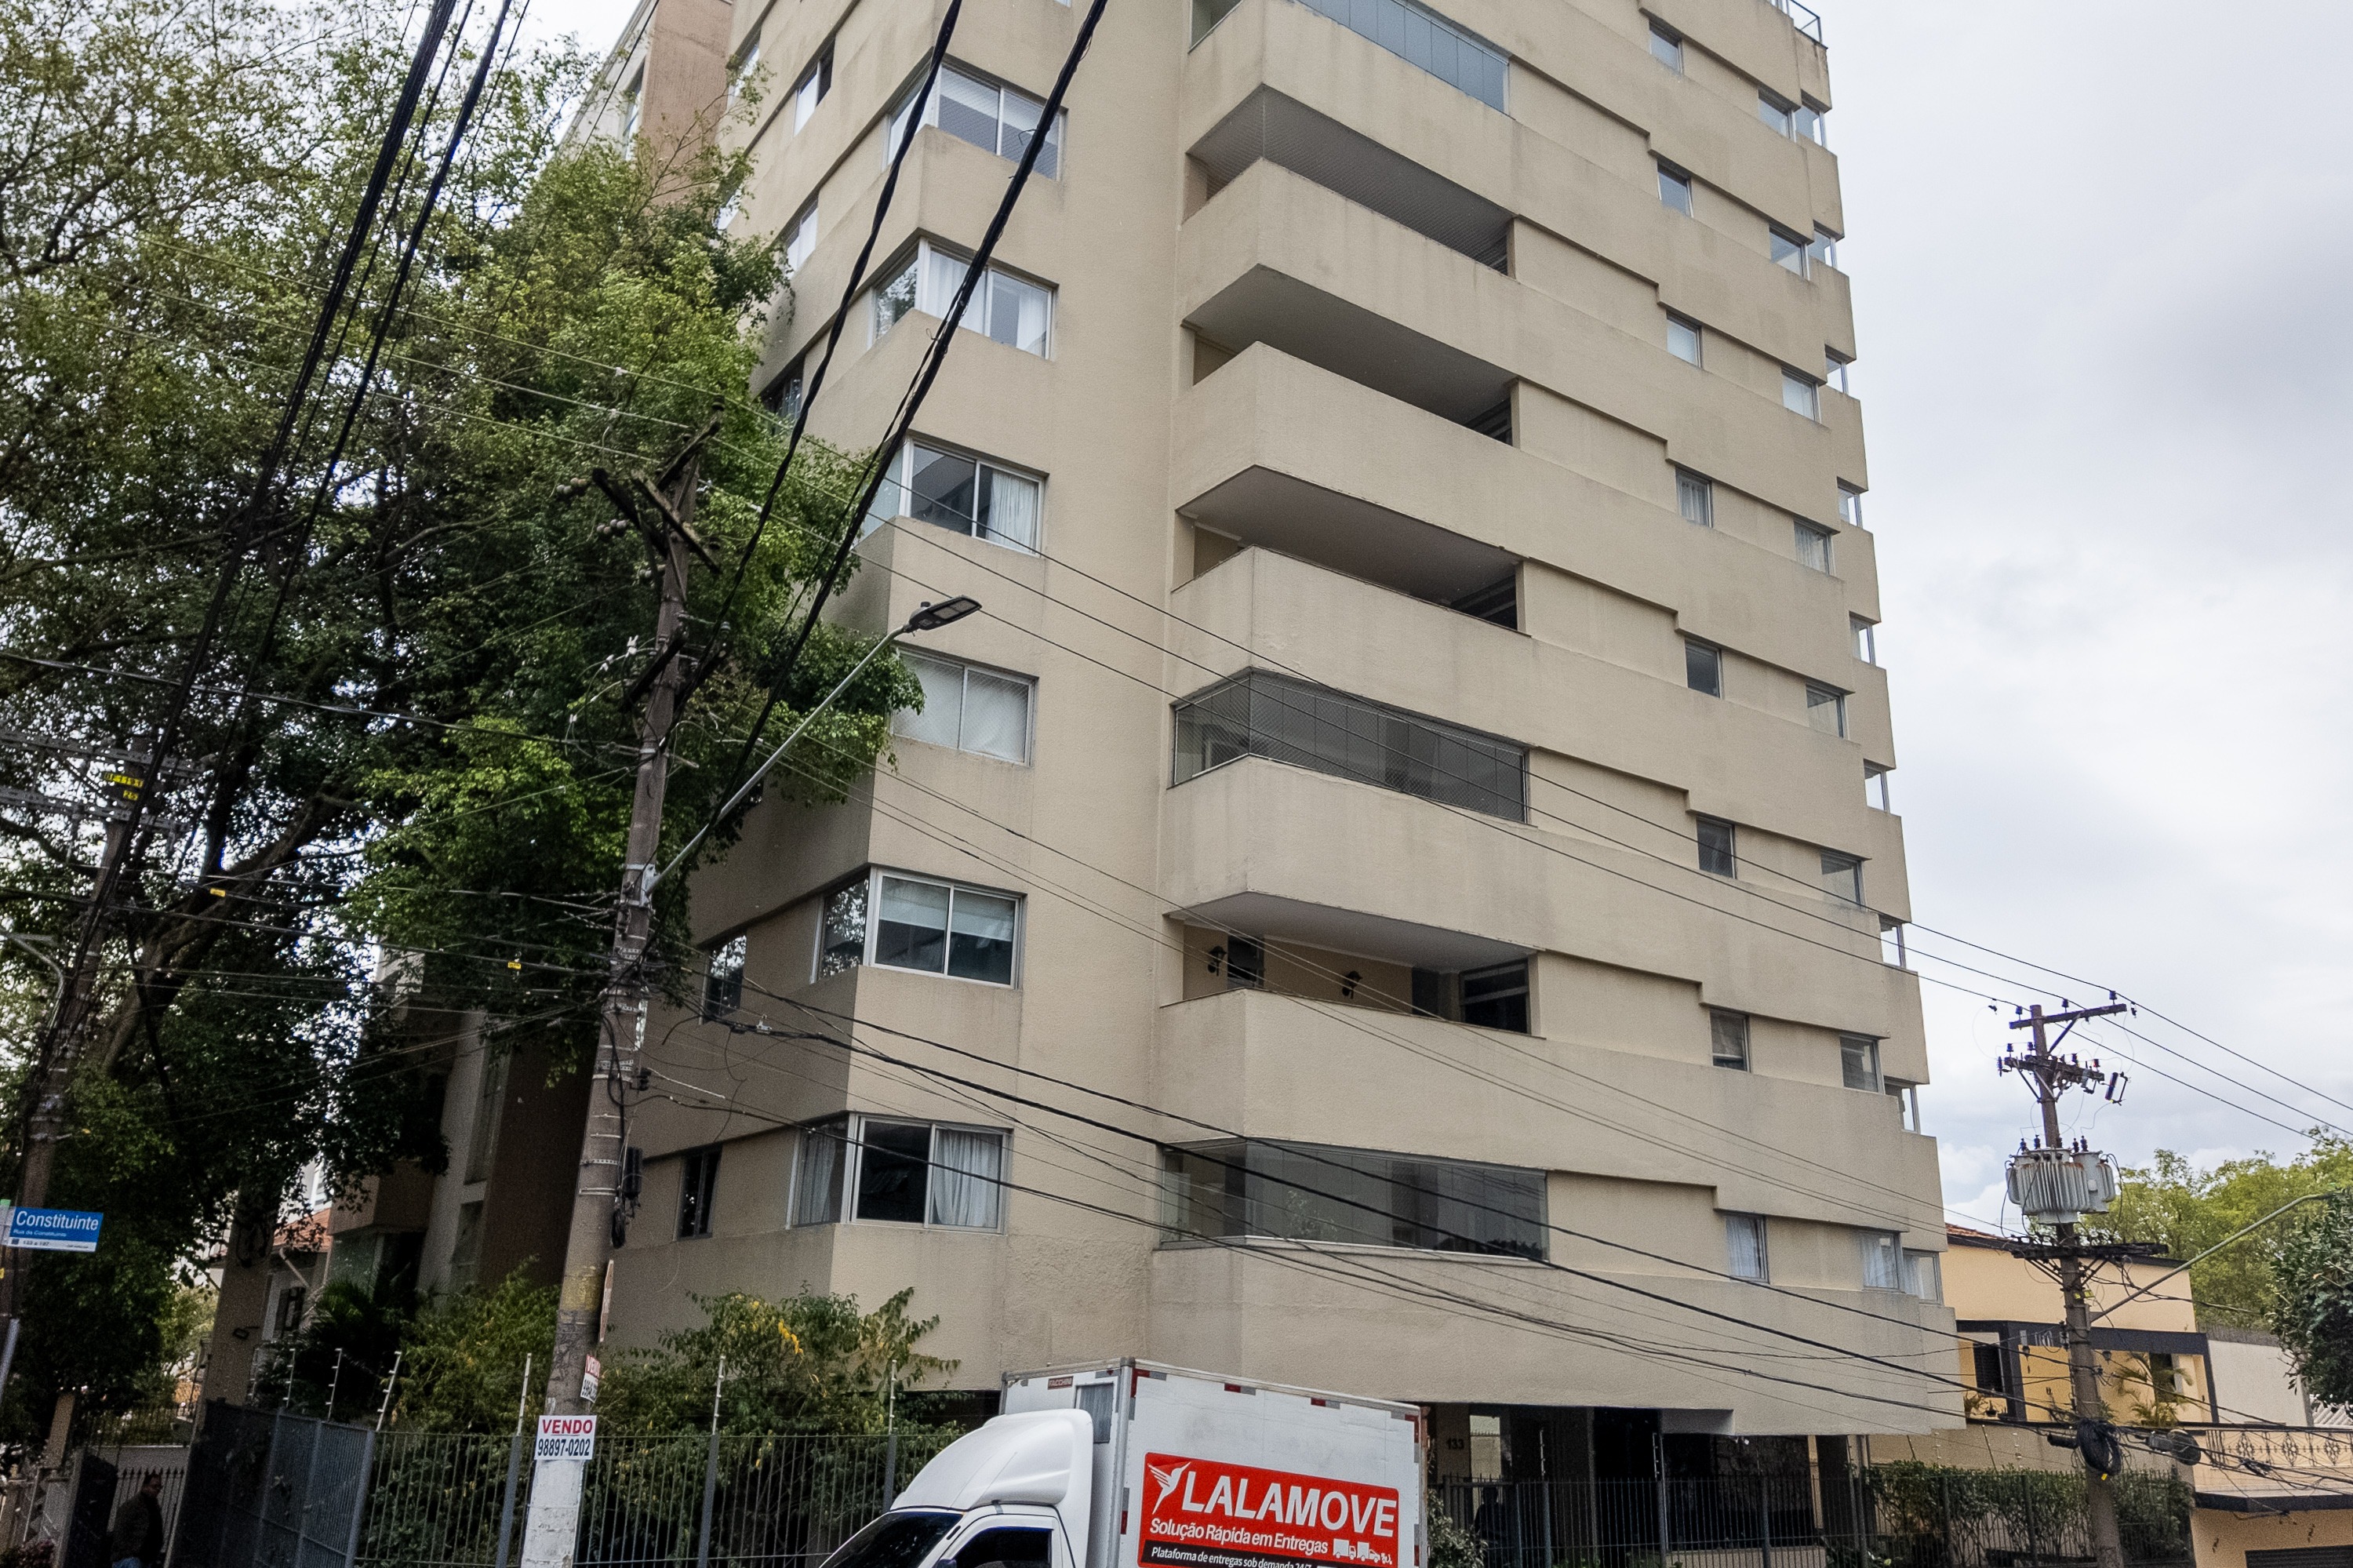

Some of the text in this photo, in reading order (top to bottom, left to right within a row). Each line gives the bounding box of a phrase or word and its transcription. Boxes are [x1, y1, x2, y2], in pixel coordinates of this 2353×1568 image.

[16, 1210, 99, 1231] Constituinte
[542, 1419, 592, 1434] VENDO
[537, 1439, 591, 1457] 98897-0202
[1181, 1471, 1397, 1537] LALAMOVE
[1150, 1518, 1329, 1556] Solução Rápida em Entregas
[1151, 1547, 1197, 1561] Plataforma
[1198, 1552, 1208, 1562] de
[1209, 1554, 1242, 1567] entregas
[1243, 1557, 1257, 1568] sob
[1258, 1559, 1294, 1568] demanda
